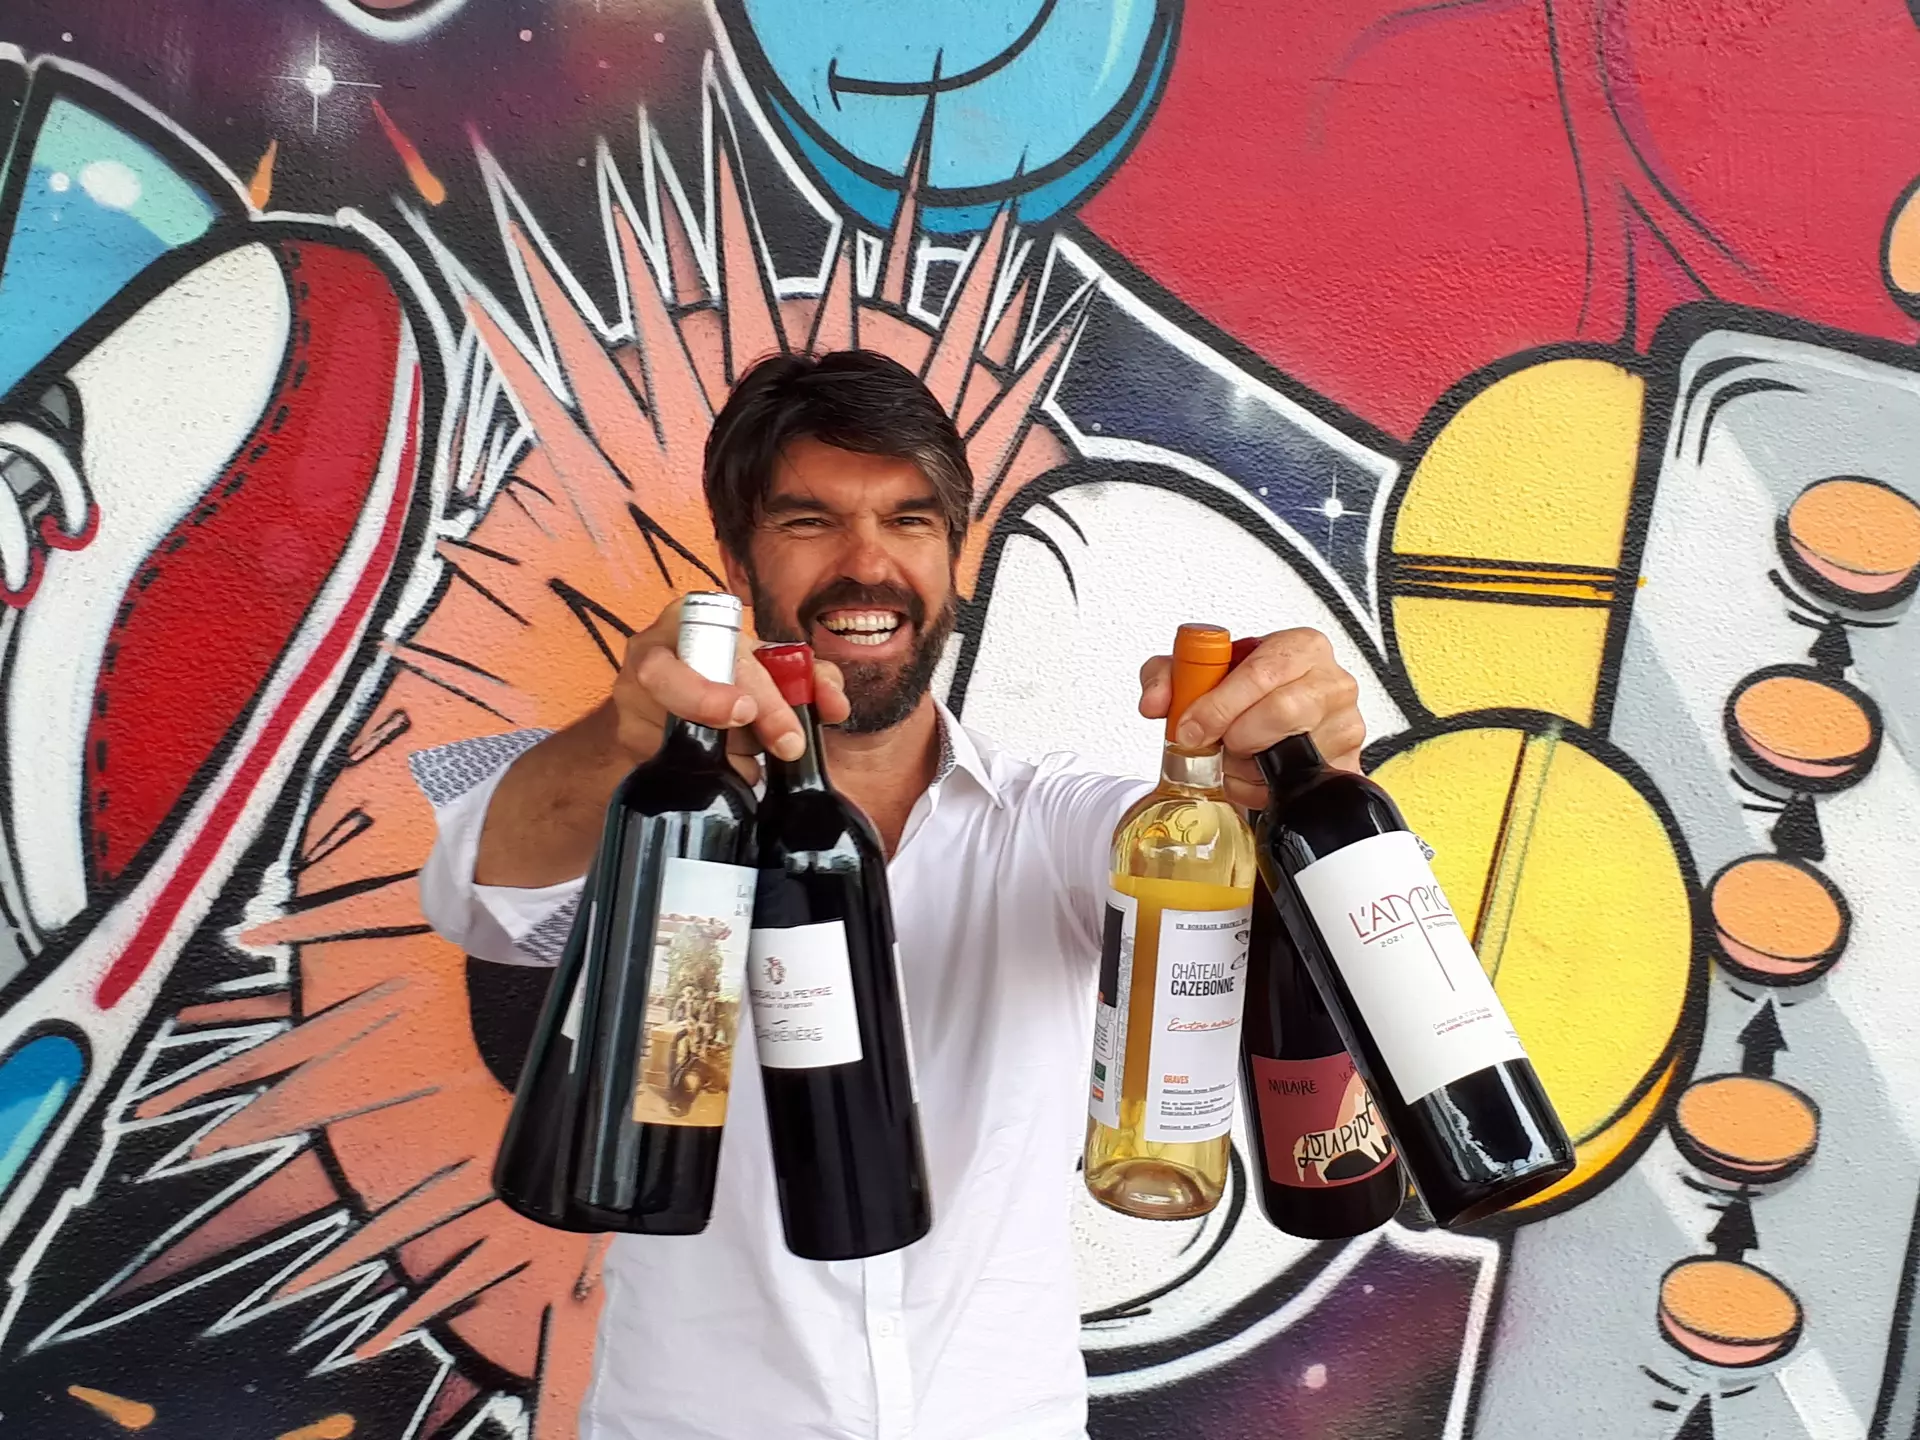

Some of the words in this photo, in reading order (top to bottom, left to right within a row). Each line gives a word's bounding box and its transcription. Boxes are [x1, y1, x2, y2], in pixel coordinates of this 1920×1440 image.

[1380, 933, 1404, 948] 2021
[1171, 961, 1225, 980] CHÂTEAU
[1170, 976, 1236, 996] CAZEBONNE
[1163, 1075, 1189, 1084] GRAVES
